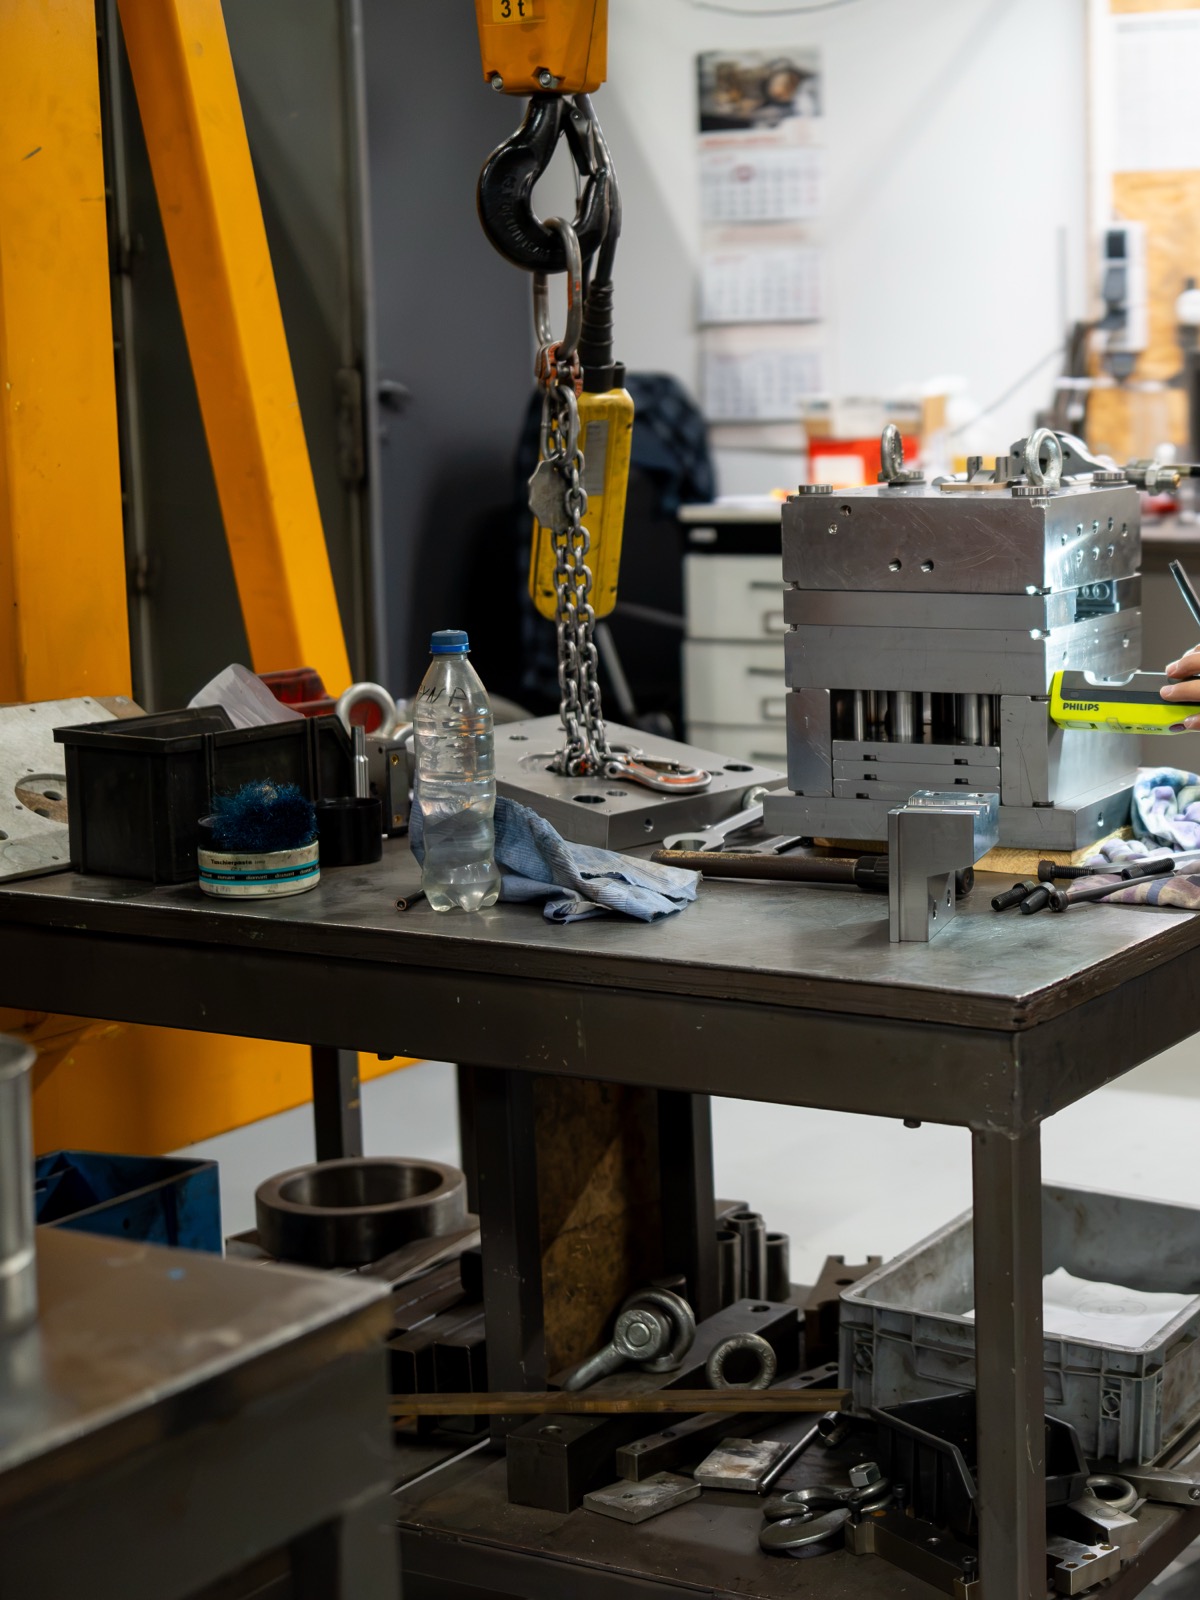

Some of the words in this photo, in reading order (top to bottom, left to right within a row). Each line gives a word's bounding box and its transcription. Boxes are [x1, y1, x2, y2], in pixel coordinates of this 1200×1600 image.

[500, 0, 511, 18] 3
[517, 0, 525, 17] t
[1062, 702, 1100, 712] PHILIPS
